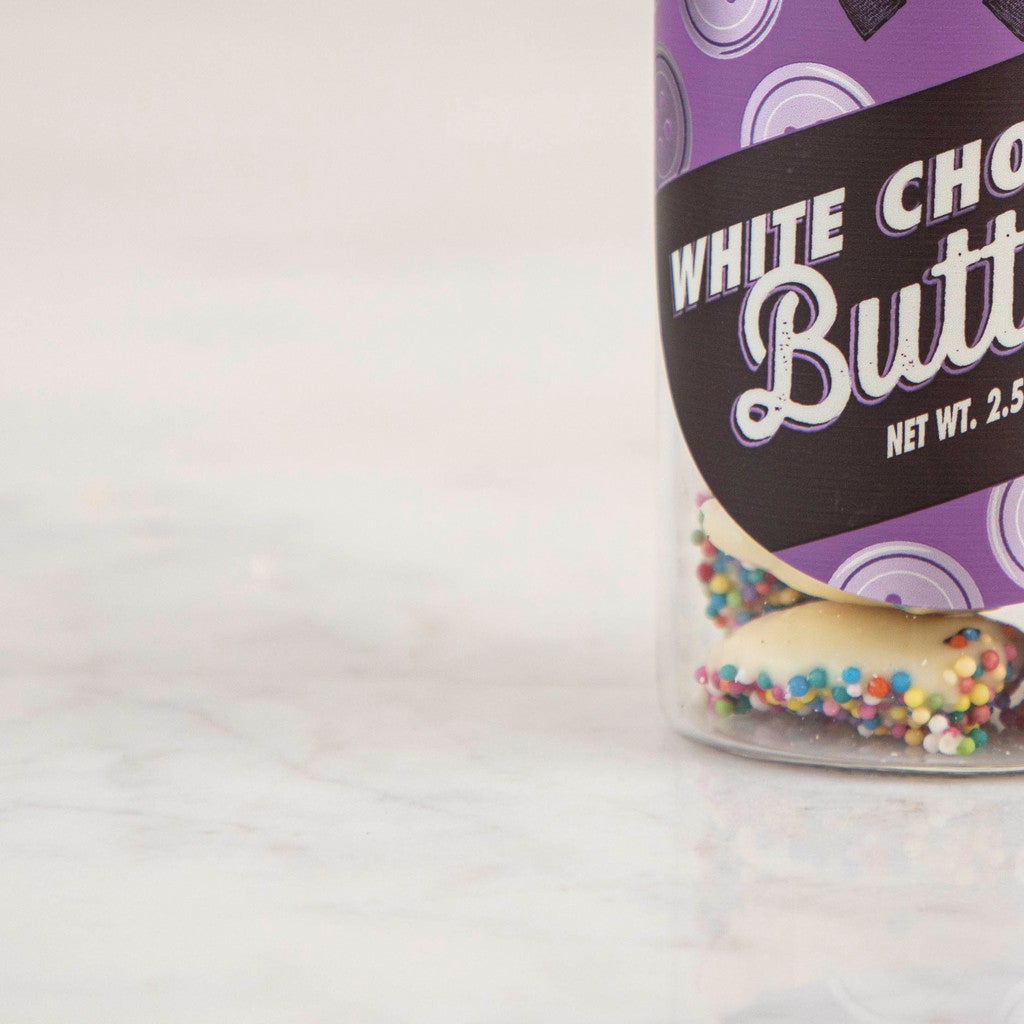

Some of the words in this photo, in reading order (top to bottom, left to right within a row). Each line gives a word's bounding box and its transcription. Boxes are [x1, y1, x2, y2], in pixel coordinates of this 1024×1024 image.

[670, 187, 846, 316] WHITE
[886, 413, 930, 459] NET
[935, 398, 978, 439] WT.
[985, 380, 1024, 425] 2.5
